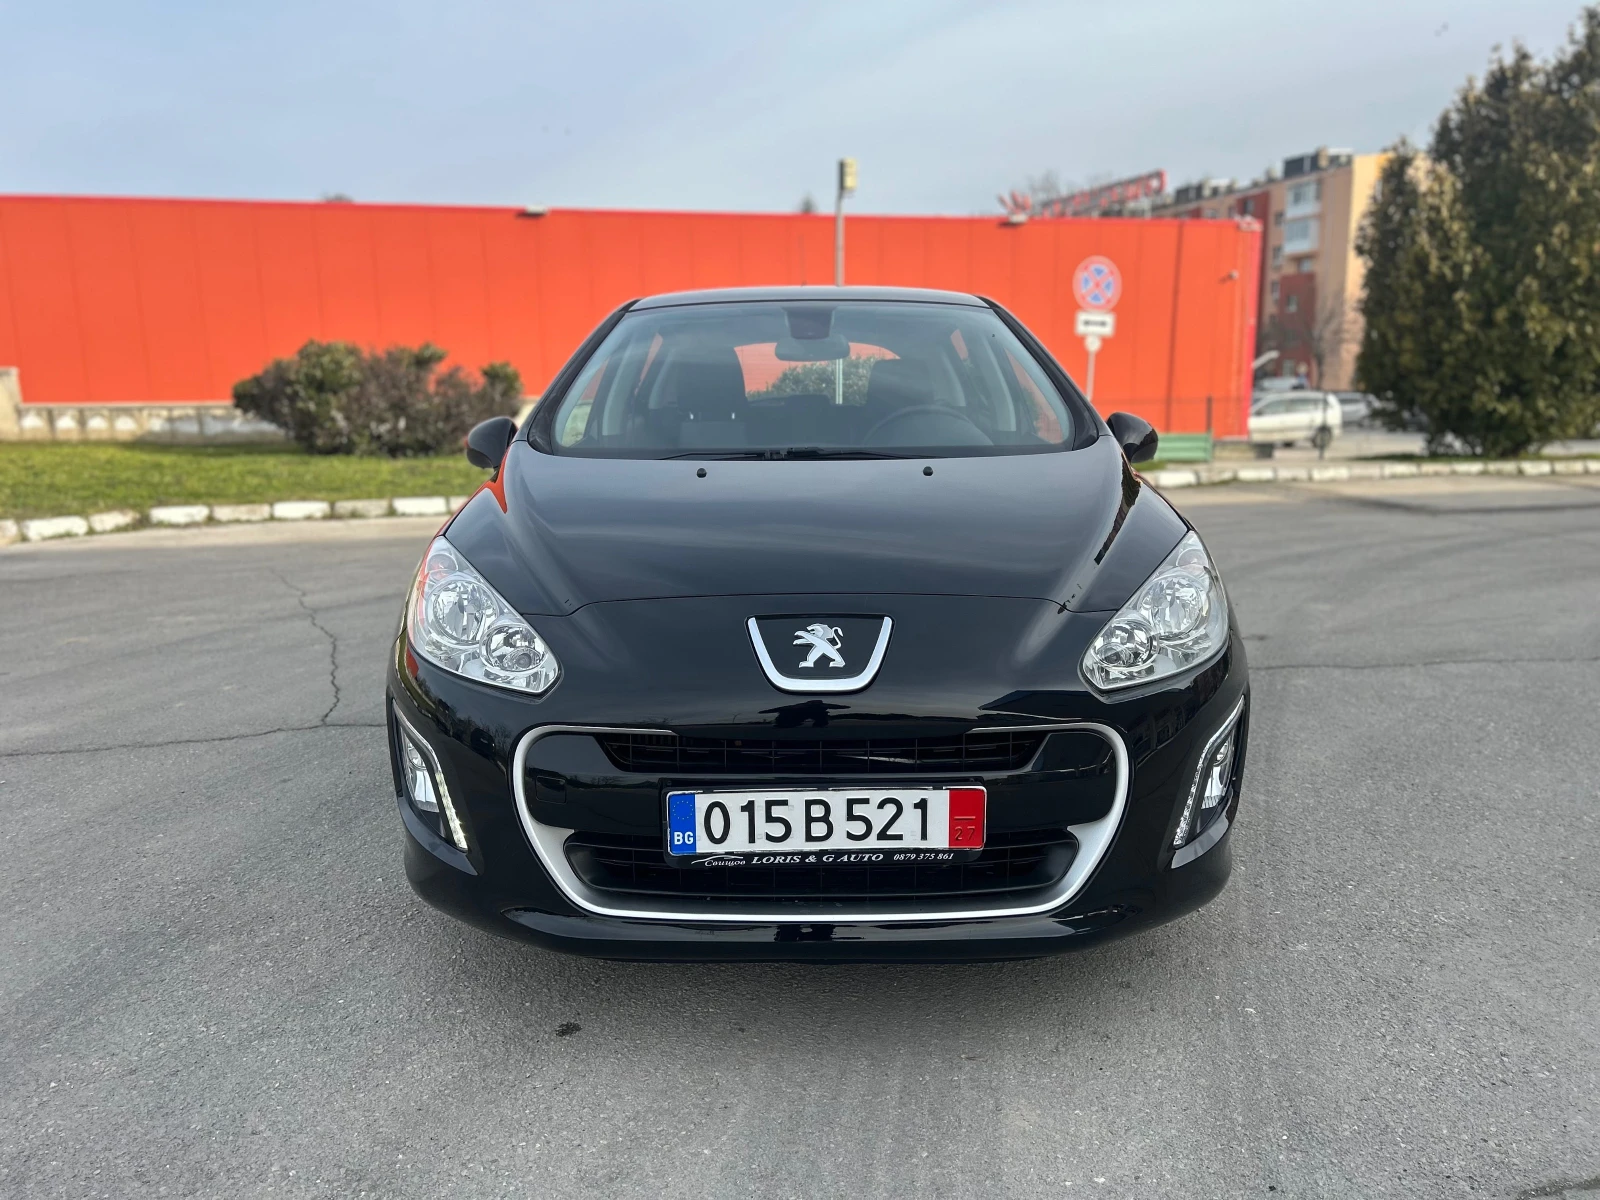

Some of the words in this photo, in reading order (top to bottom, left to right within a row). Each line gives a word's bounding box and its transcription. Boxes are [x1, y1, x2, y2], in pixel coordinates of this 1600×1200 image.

[673, 831, 694, 845] BG
[703, 797, 929, 845] 015B521
[954, 825, 976, 841] 27
[751, 855, 802, 864] LORIS
[804, 855, 818, 863] &
[822, 854, 835, 863] G
[837, 853, 884, 862] AUTO
[893, 853, 917, 861] 0879
[936, 852, 954, 860] 861
